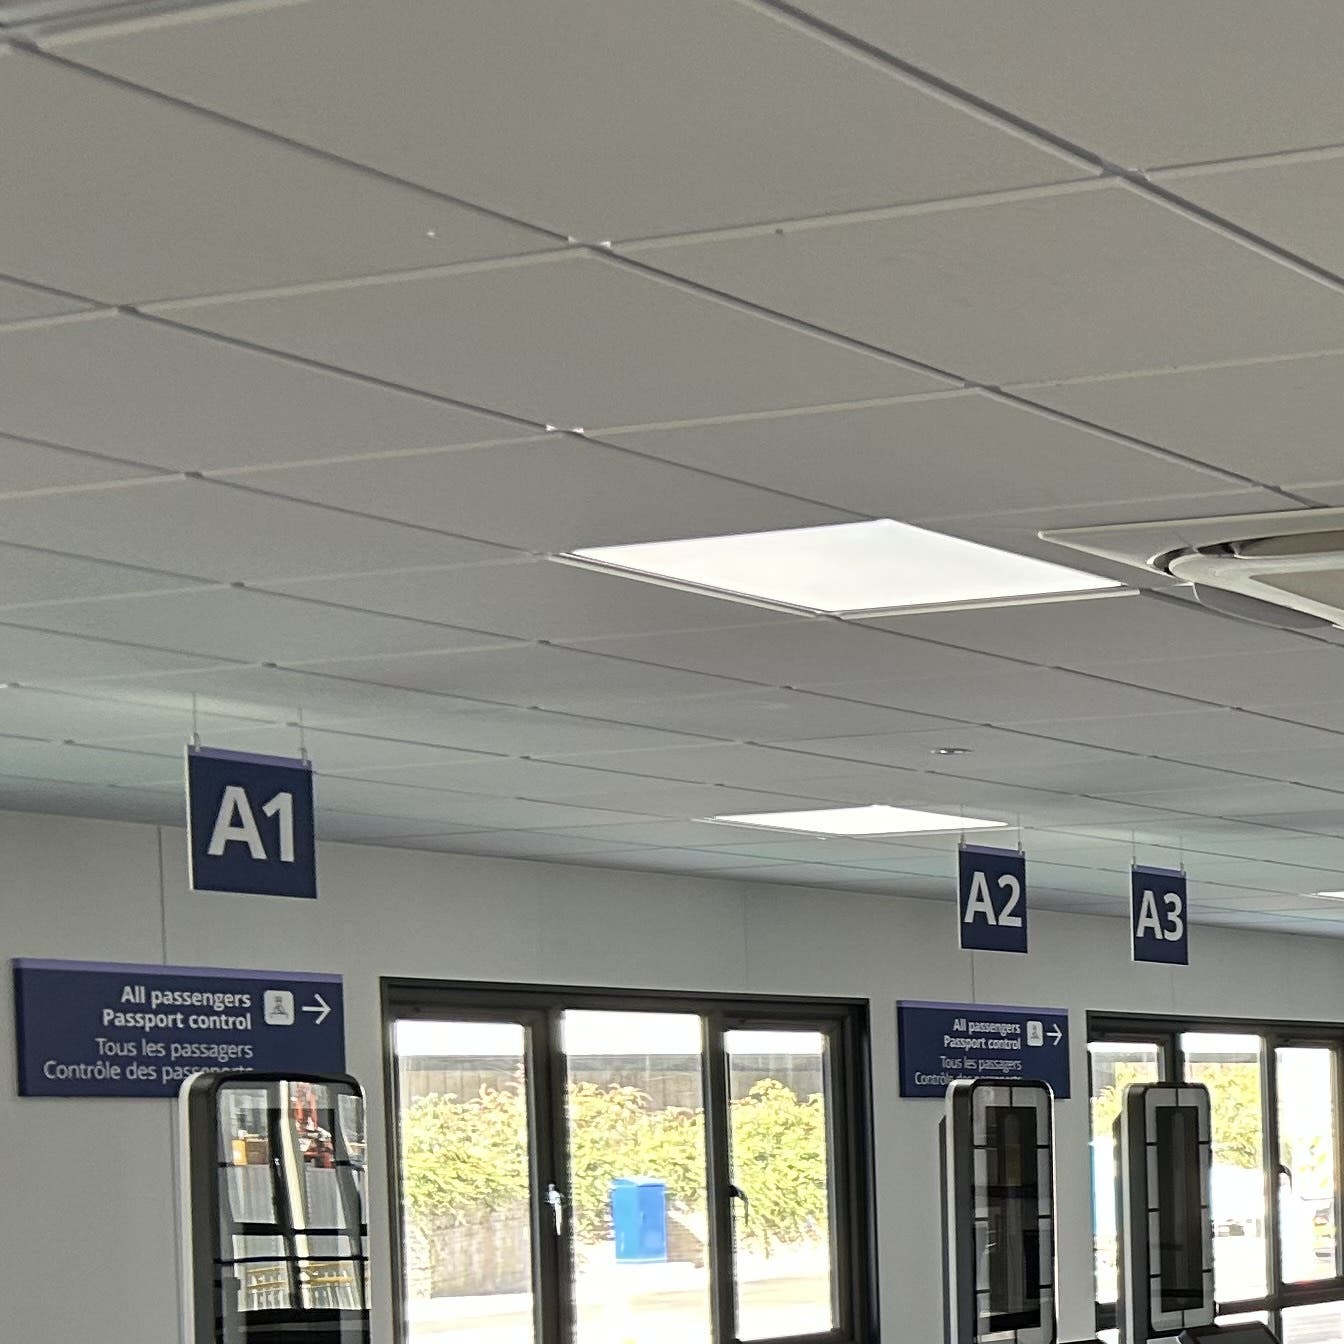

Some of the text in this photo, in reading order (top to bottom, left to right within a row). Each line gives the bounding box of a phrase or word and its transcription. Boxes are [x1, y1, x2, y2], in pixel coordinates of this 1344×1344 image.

[207, 785, 295, 863] A1
[963, 871, 1023, 928] A2
[1136, 890, 1184, 942] A3
[121, 985, 251, 1011] All passengers
[103, 1009, 252, 1031] Passport control
[953, 1018, 1021, 1036] All passengers
[95, 1038, 253, 1062] Tous les passagers
[943, 1035, 1021, 1051] Passport control
[43, 1060, 121, 1080] Contrôle
[126, 1061, 157, 1080] des
[940, 1056, 1022, 1073] Tous les passagers
